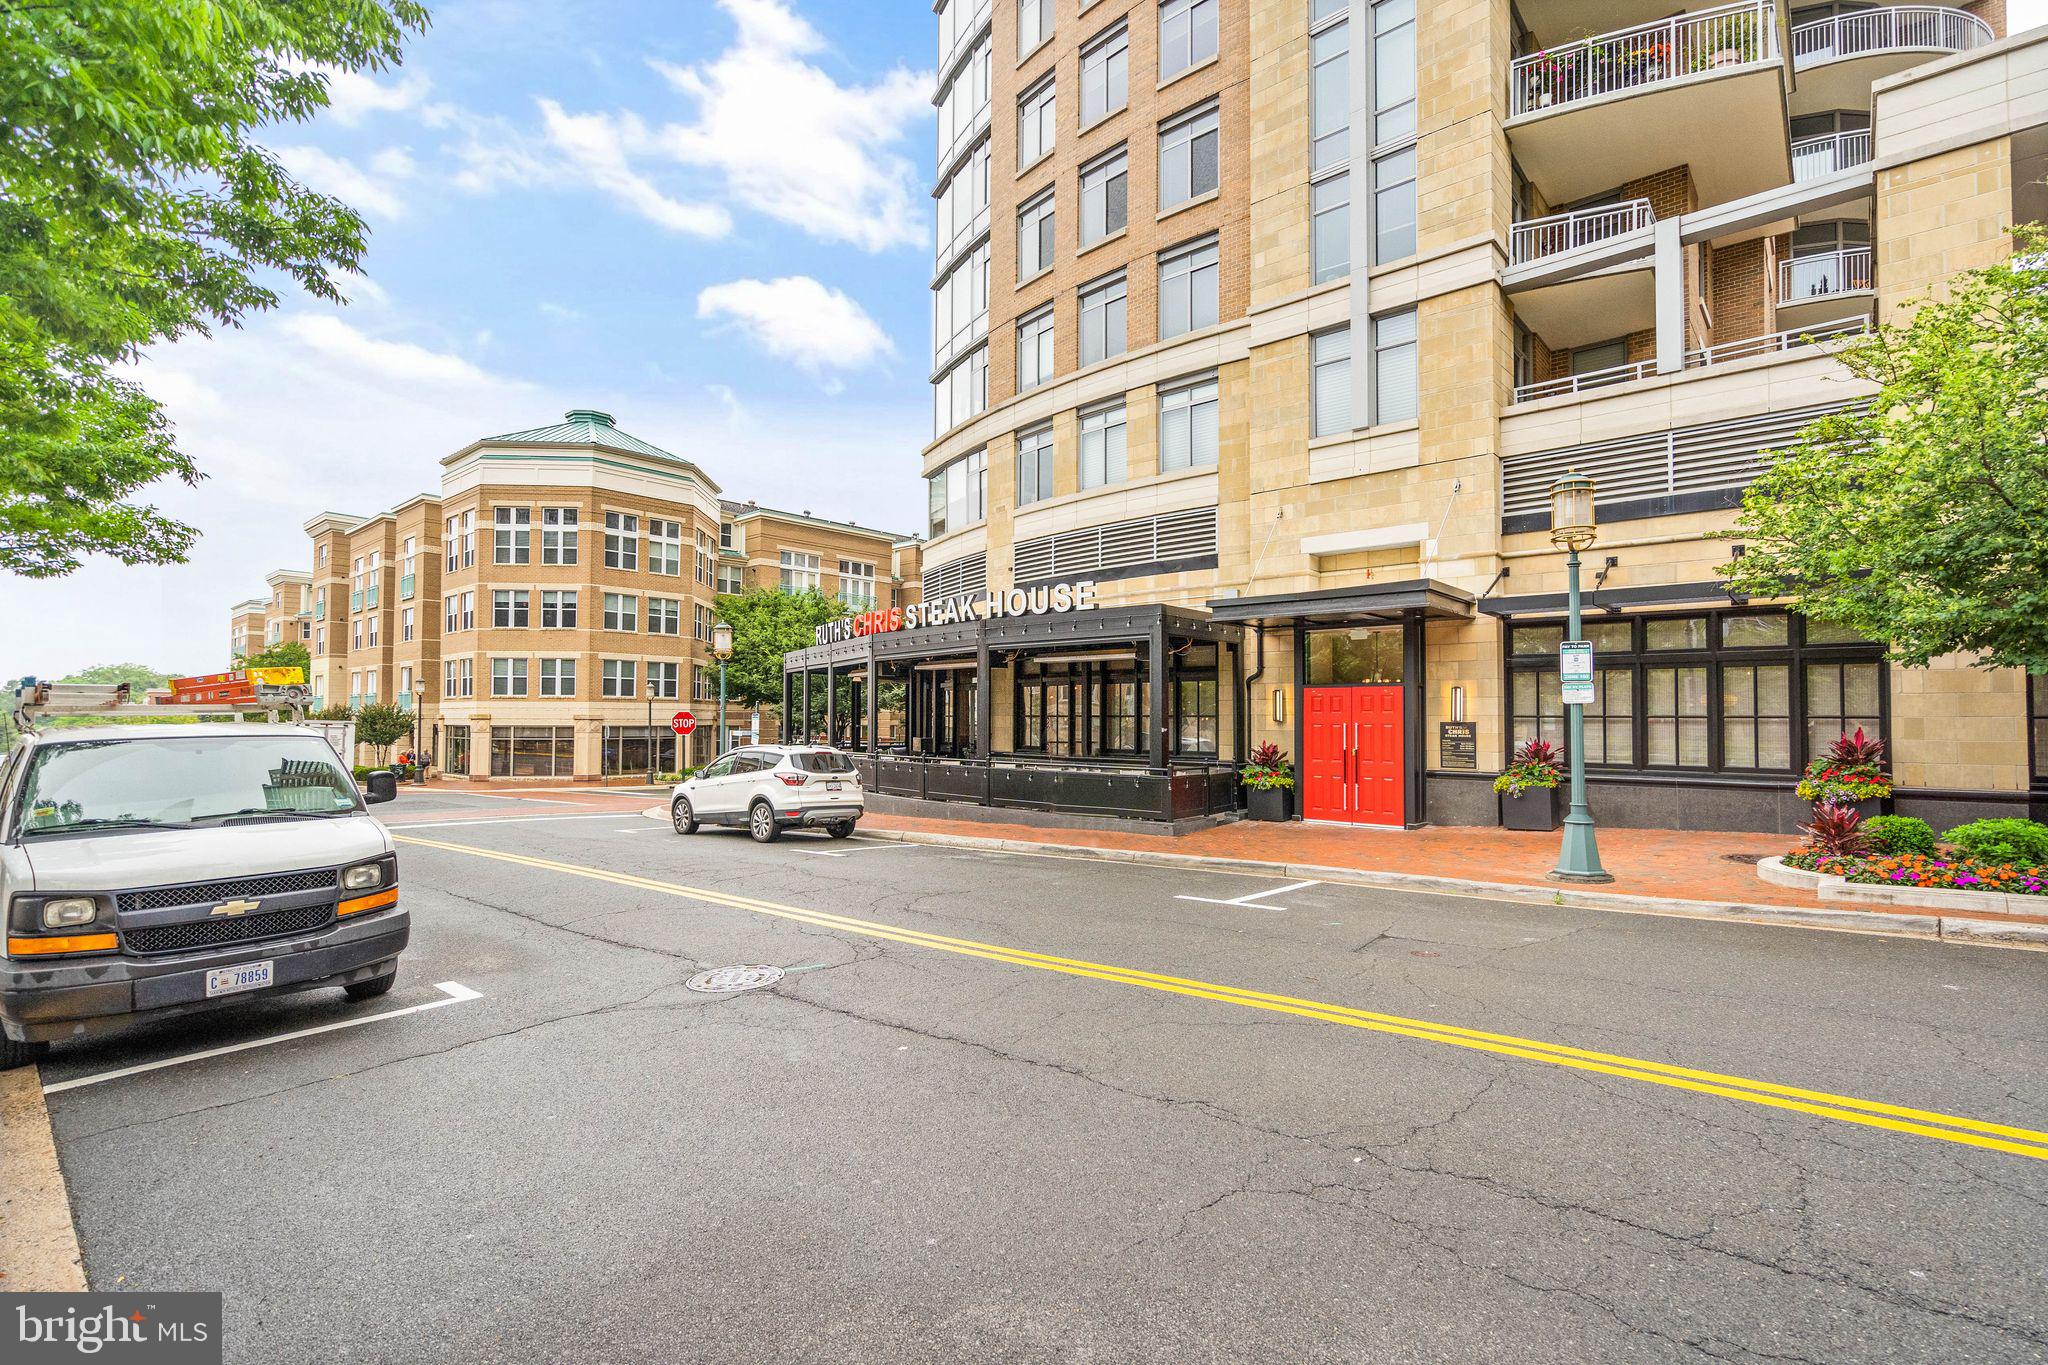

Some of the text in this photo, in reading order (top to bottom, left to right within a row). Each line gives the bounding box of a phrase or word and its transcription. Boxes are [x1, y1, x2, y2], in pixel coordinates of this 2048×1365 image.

[815, 580, 1097, 646] RUTH'S CHRIS STEAK HOUSE
[673, 719, 694, 728] STOP
[211, 976, 217, 989] C
[234, 968, 268, 985] 78859
